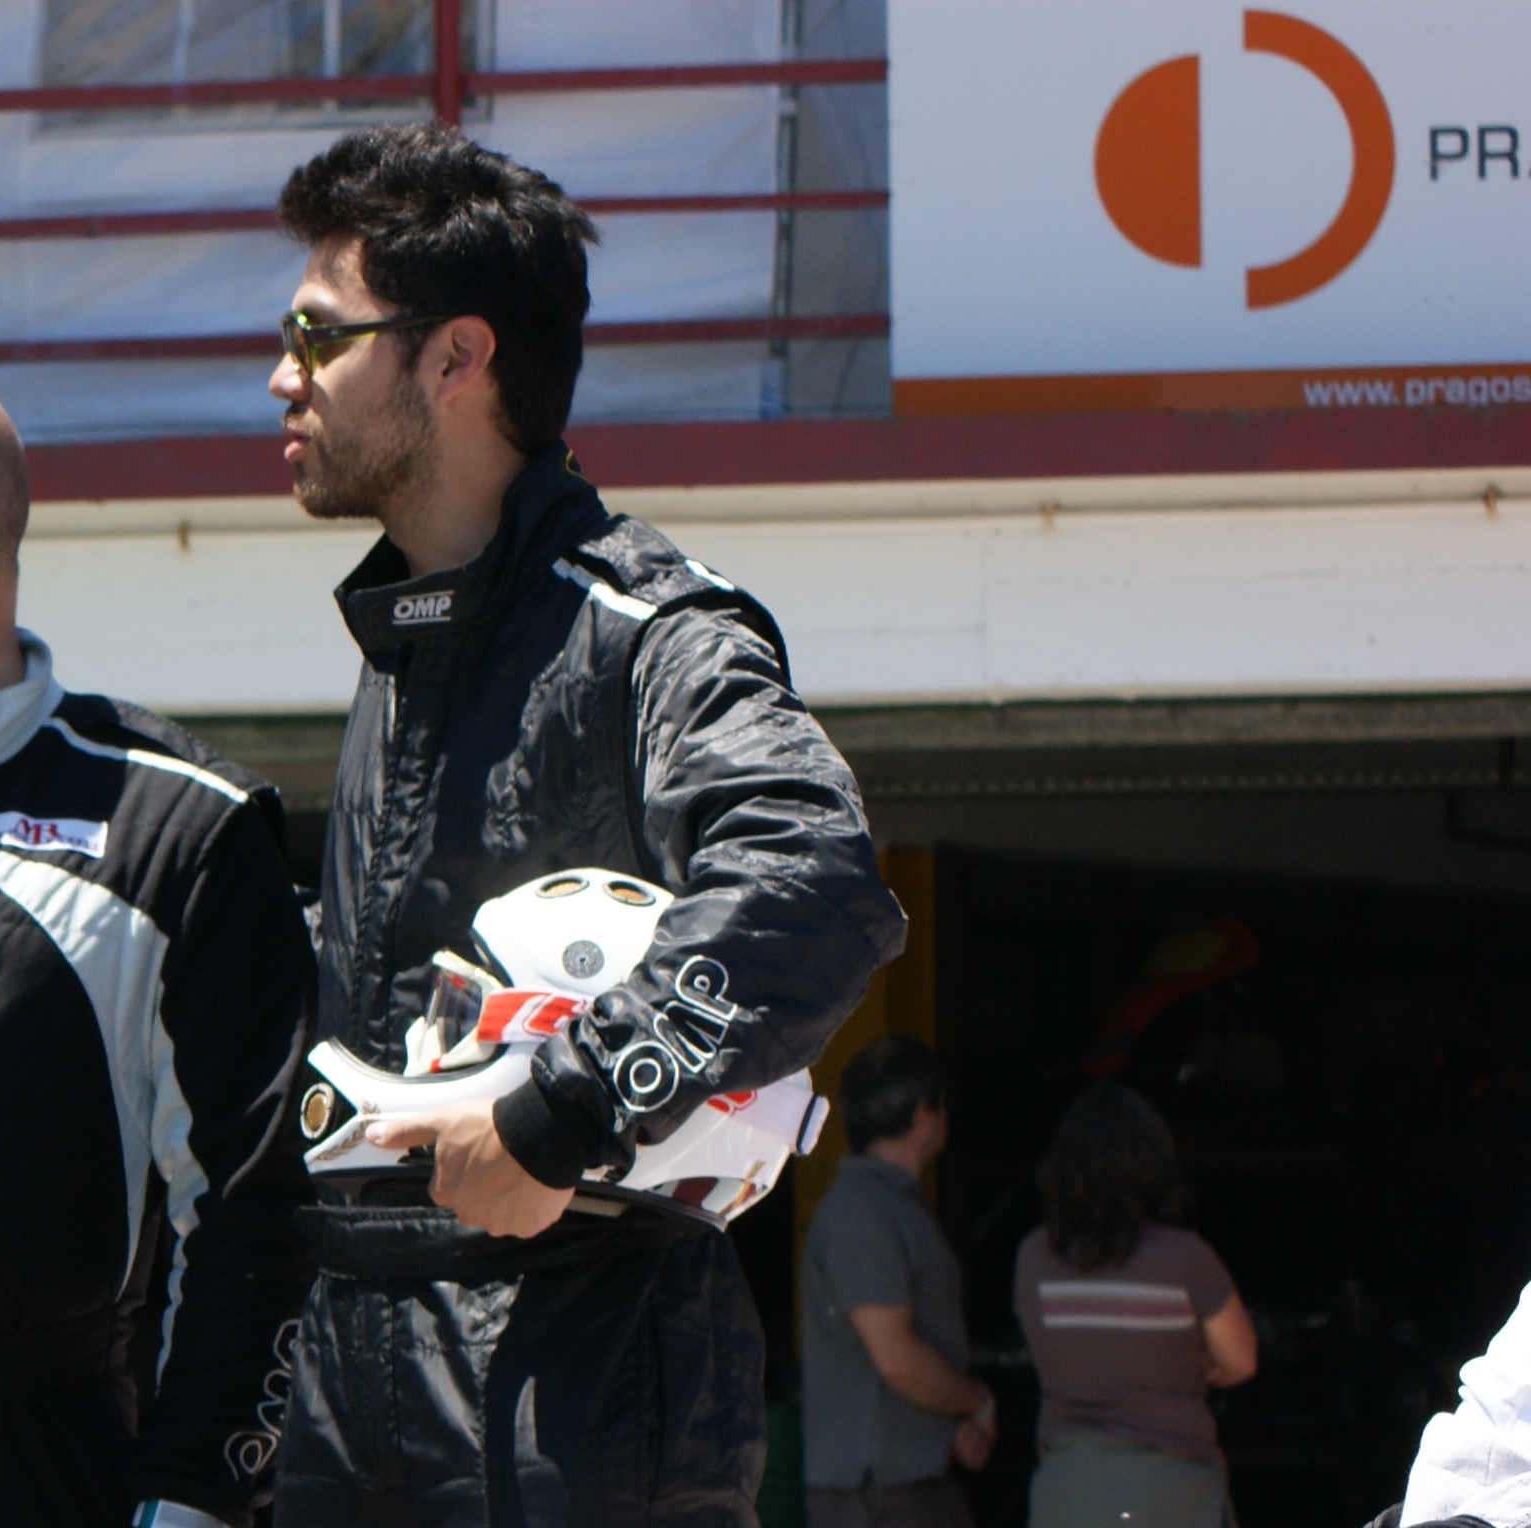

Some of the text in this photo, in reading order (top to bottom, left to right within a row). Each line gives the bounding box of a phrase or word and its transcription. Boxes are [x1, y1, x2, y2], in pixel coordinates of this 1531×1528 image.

[1429, 125, 1531, 181] PR
[393, 596, 452, 619] OMP
[613, 954, 737, 1114] OMP
